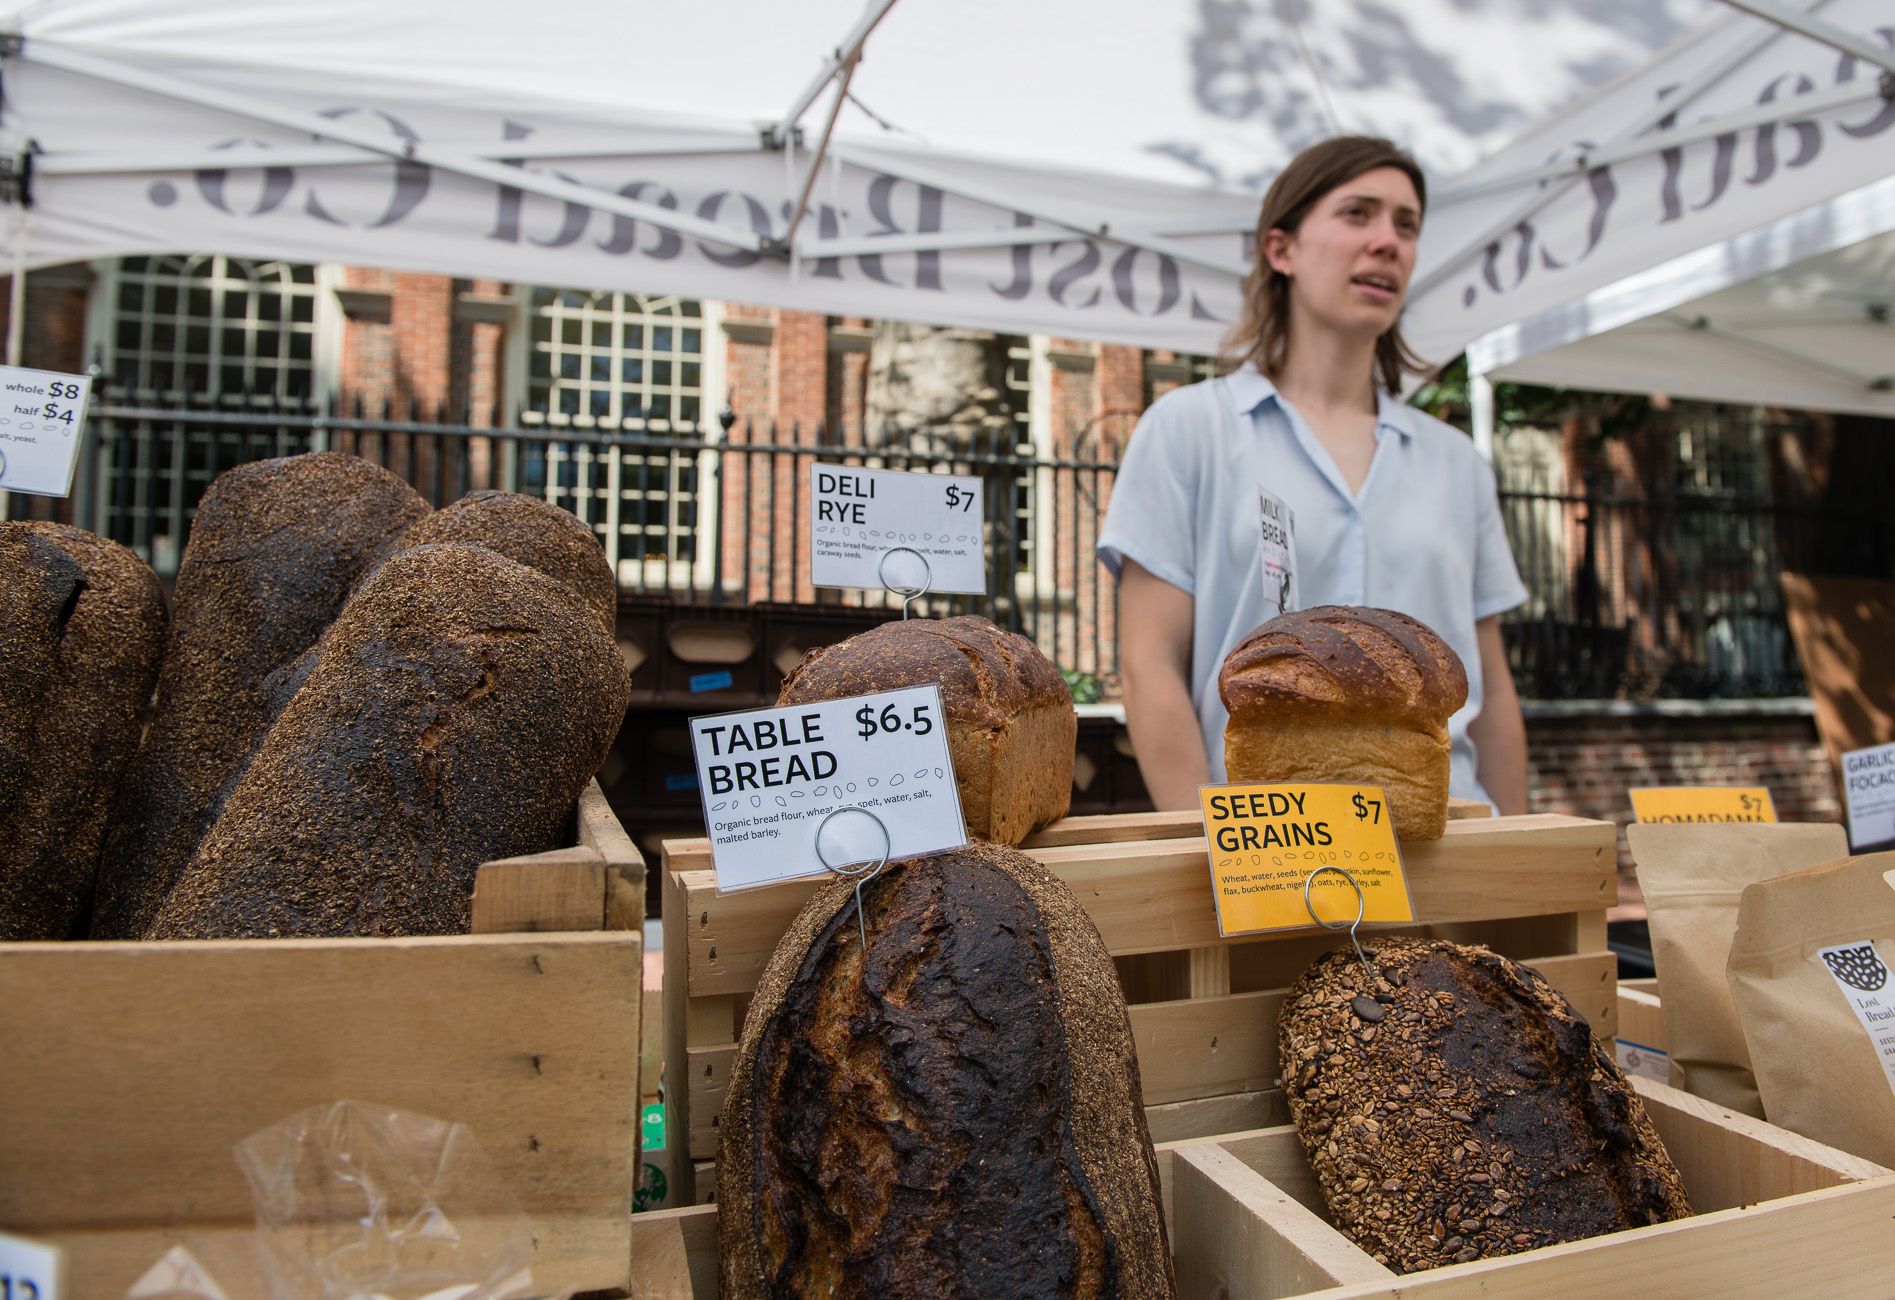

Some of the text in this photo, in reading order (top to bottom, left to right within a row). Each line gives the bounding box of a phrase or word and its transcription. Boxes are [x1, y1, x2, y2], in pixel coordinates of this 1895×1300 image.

[5, 380, 79, 399] whole $8
[14, 402, 75, 425] half $4
[818, 473, 975, 512] DELI $7
[818, 499, 866, 525] RYE
[816, 539, 842, 549] Organic
[842, 541, 861, 550] bread
[933, 548, 954, 557] water,
[816, 550, 864, 559] caraway seeds.
[701, 703, 933, 756] TABLE $6.5
[1848, 750, 1894, 772] GARLIC
[708, 751, 838, 795] BREAD
[714, 818, 752, 832] Organic
[753, 813, 779, 825] bread
[780, 811, 805, 821] flour,
[857, 797, 883, 808] spelt,
[883, 793, 912, 804] water,
[913, 789, 932, 800] salt,
[1210, 792, 1381, 824] SEEDY $7
[1740, 793, 1762, 813] $7
[716, 828, 781, 845] malted barley.
[1216, 822, 1333, 852] GRAINS
[1222, 874, 1251, 884] Wheat,
[1251, 872, 1275, 881] water,
[1276, 869, 1298, 878] seeds
[1362, 867, 1393, 877] sunflower,
[1223, 887, 1240, 895] flax,
[1241, 883, 1286, 894] buckwheat,
[1286, 879, 1316, 890] nigell),
[1317, 879, 1335, 887] oats,
[1335, 880, 1348, 888] rye,
[1857, 996, 1881, 1009] Lost
